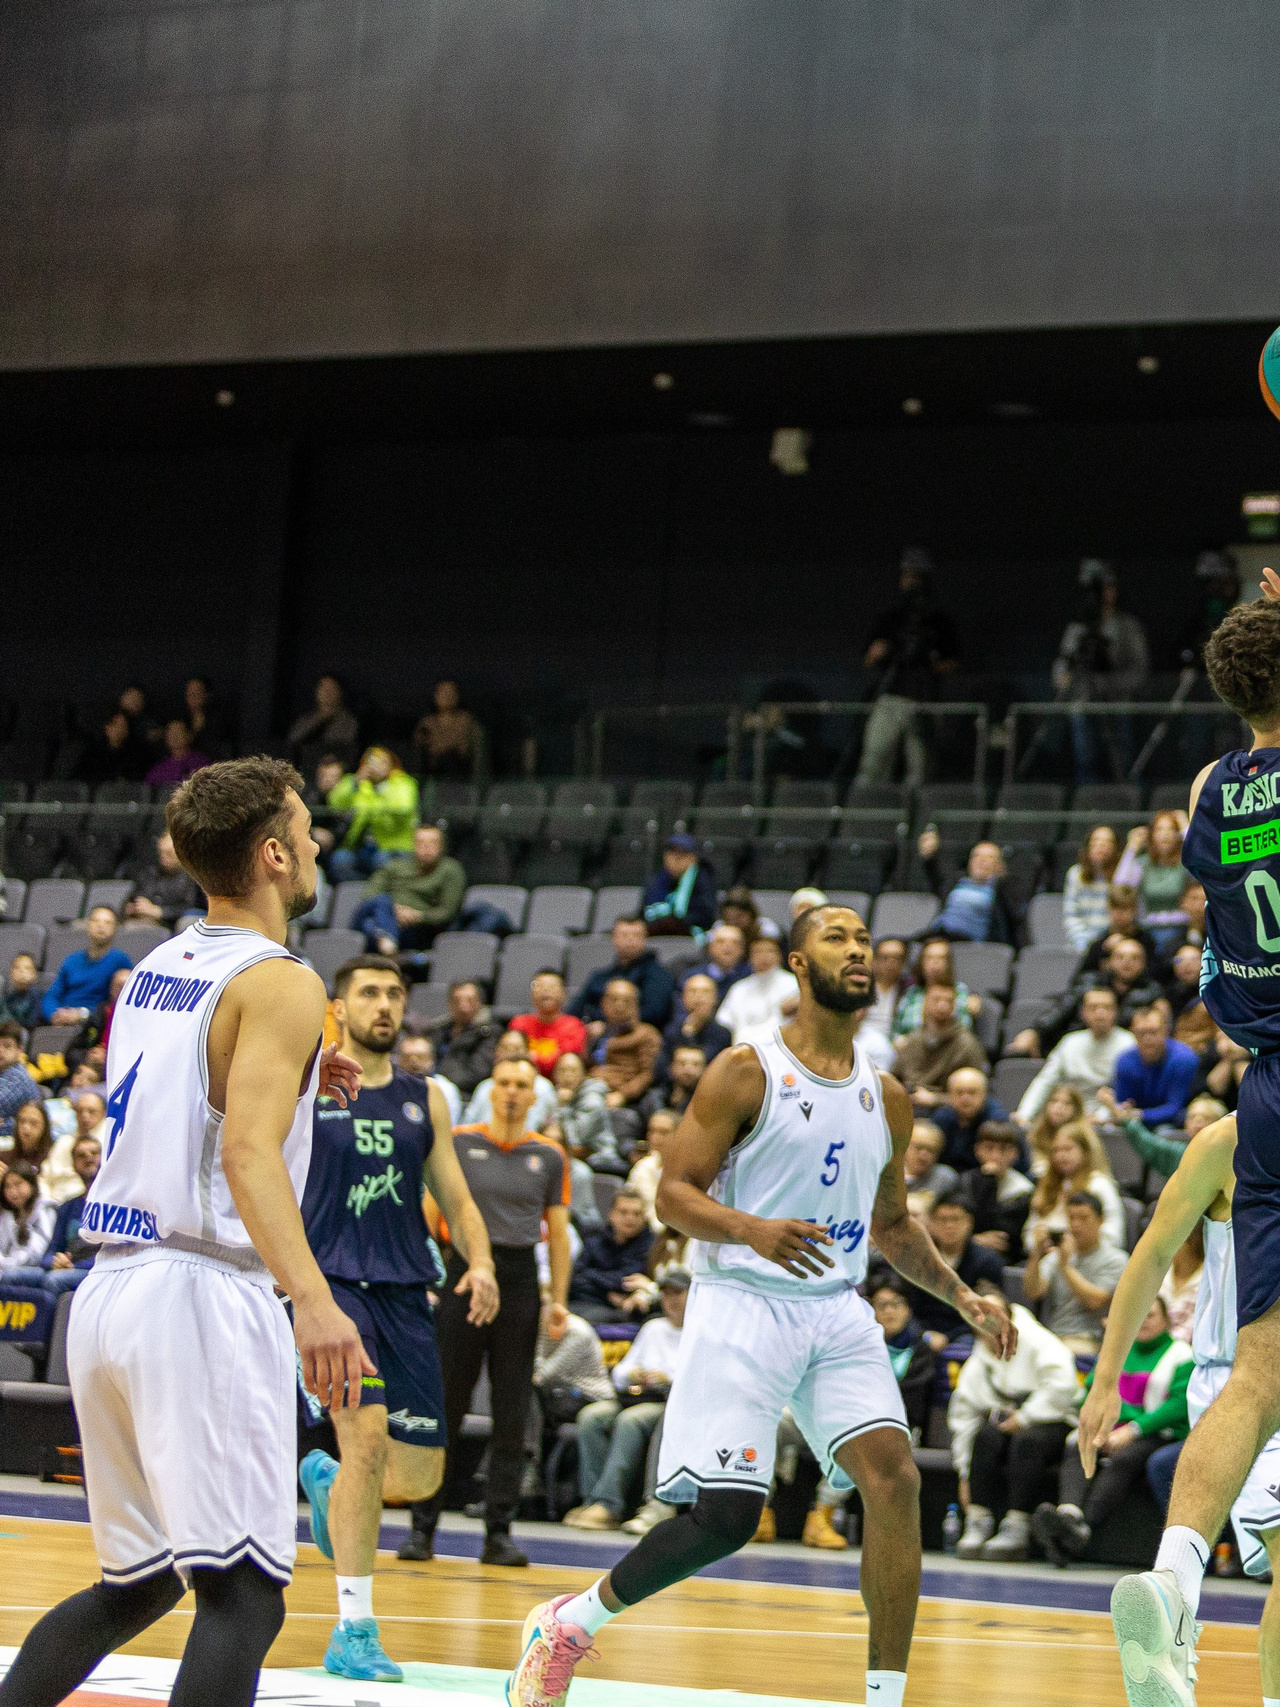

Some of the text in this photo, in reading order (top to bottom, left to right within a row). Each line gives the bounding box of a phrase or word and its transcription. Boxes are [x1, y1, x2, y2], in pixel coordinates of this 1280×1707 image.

[125, 970, 214, 1013] TOPTUNOV
[353, 1118, 395, 1158] 55
[820, 1140, 845, 1187] 5
